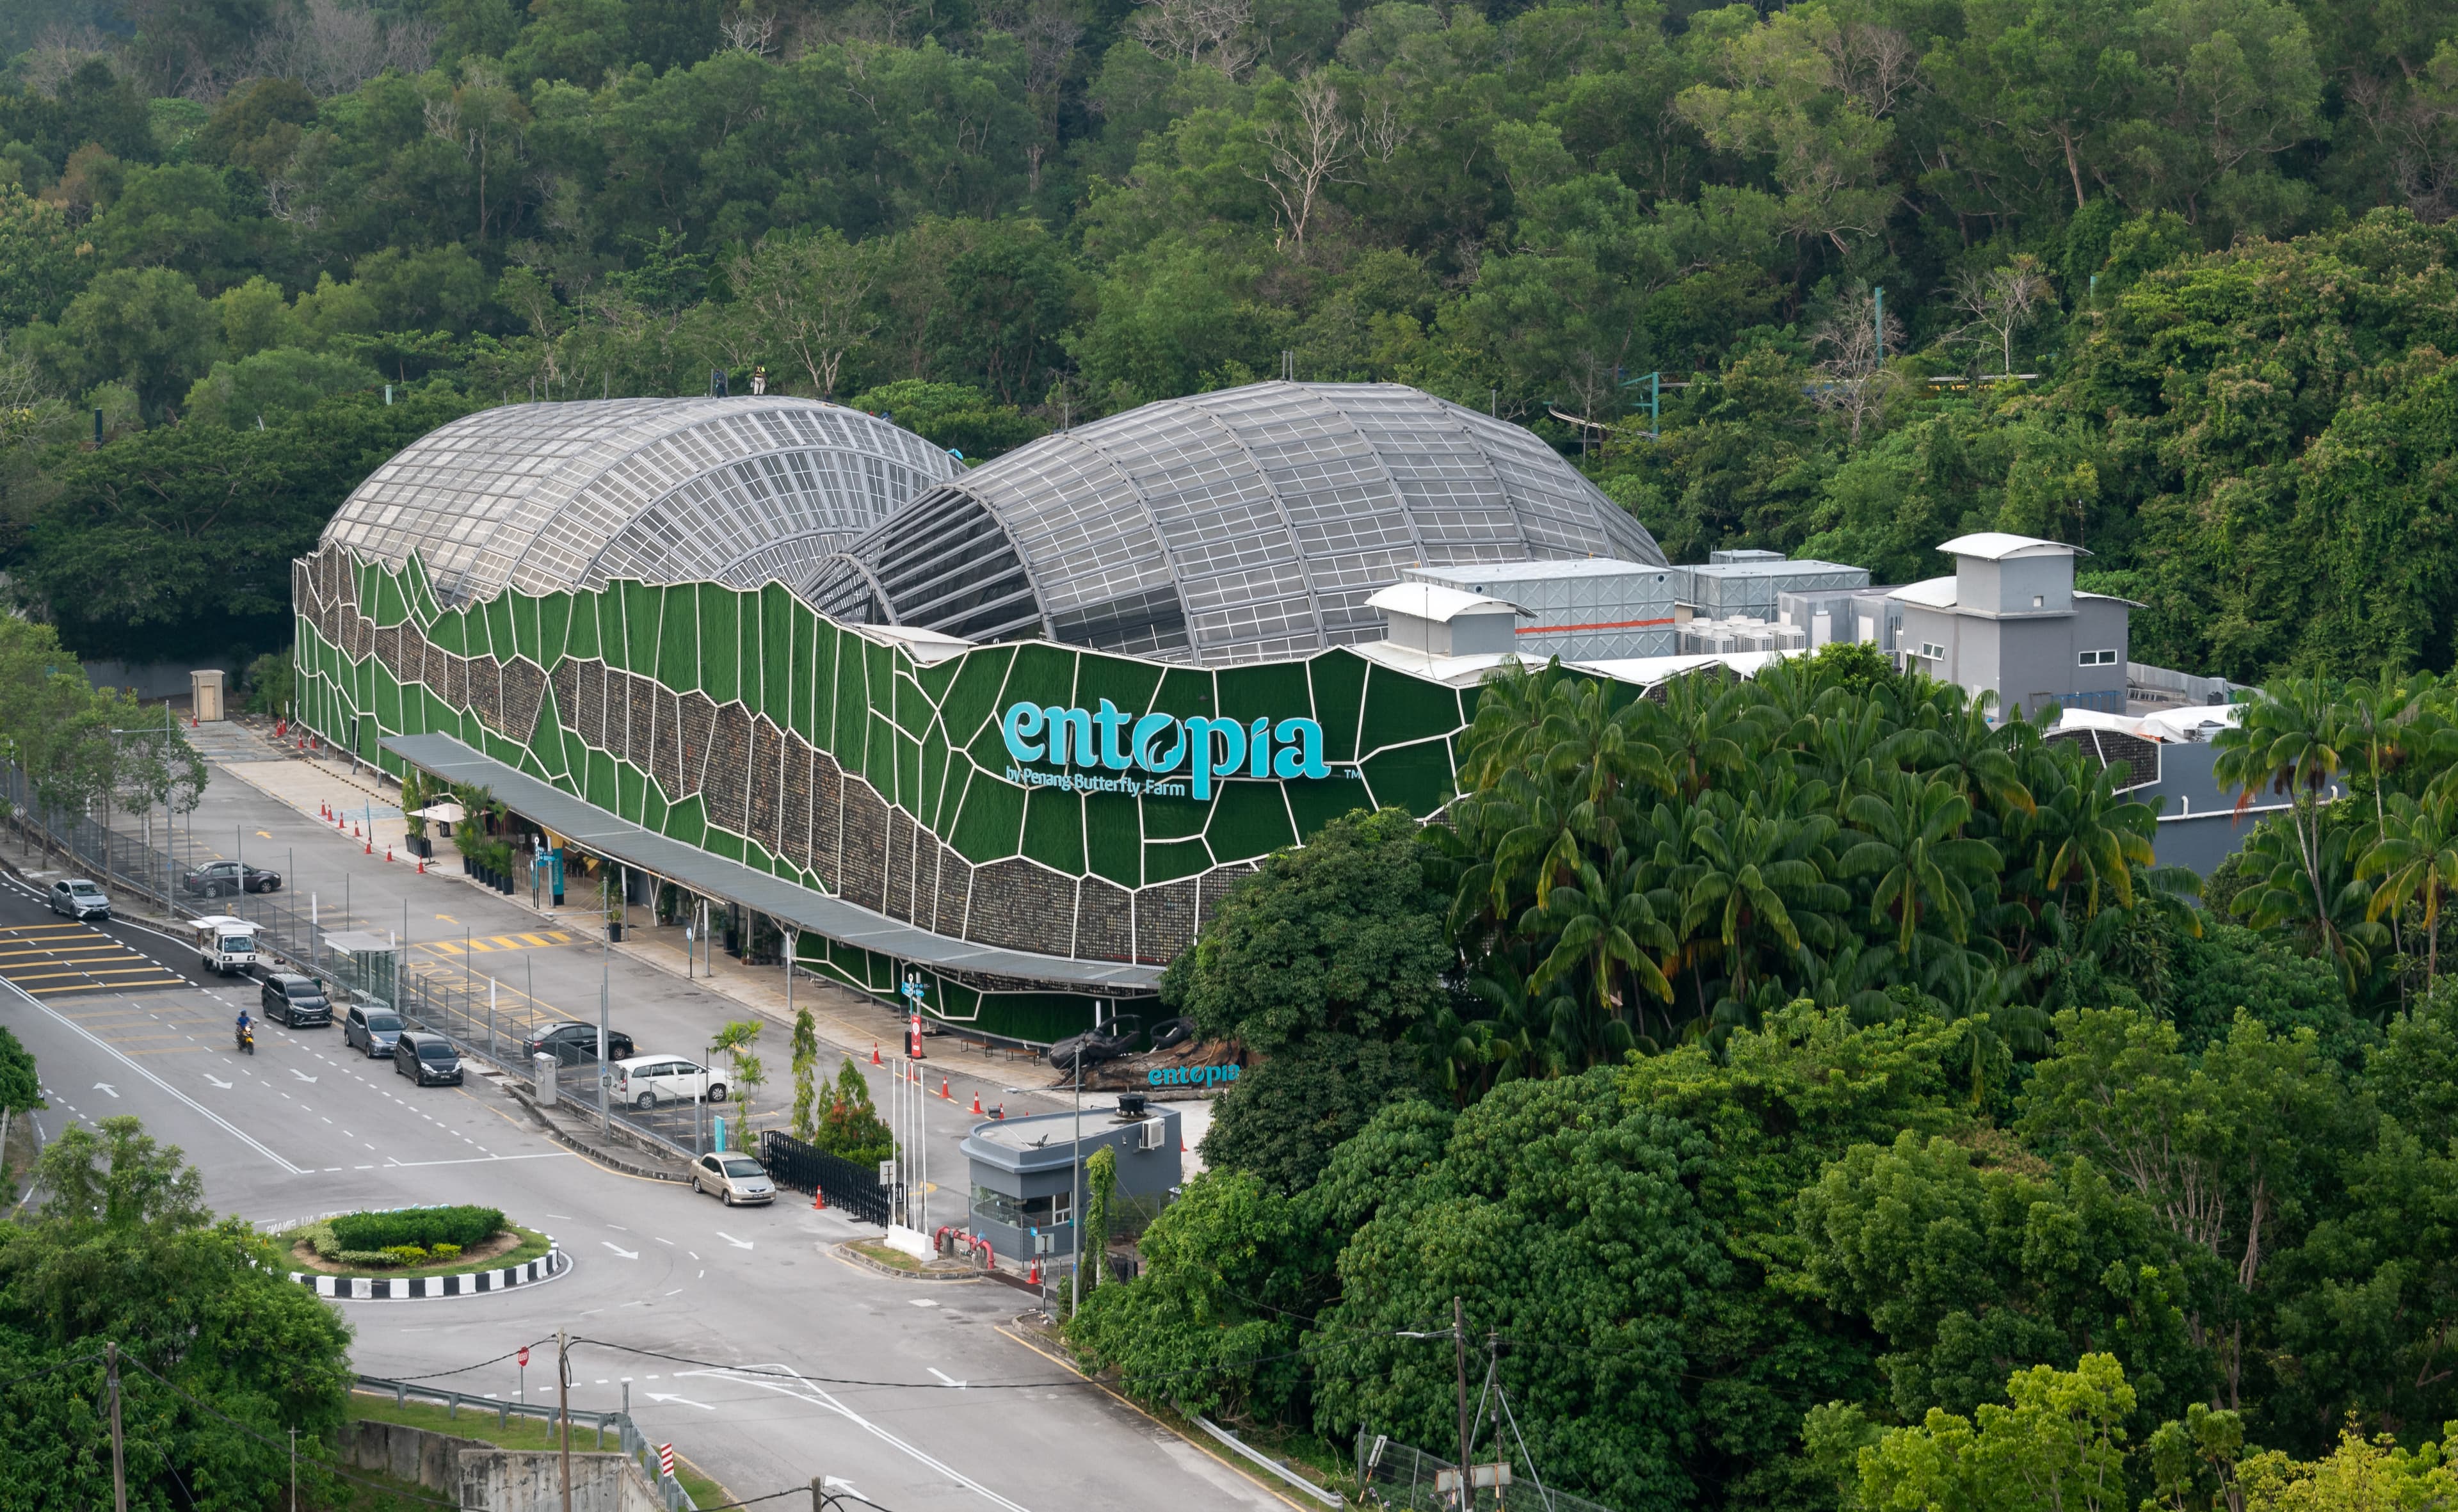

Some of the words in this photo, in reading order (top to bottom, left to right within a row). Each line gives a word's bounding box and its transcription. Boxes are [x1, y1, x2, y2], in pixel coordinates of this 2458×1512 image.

[1003, 698, 1331, 800] entopia
[1006, 766, 1021, 784] by
[1023, 768, 1071, 791] Penang
[1075, 773, 1140, 797] Butterfly
[1146, 779, 1185, 797] Farm
[1344, 769, 1361, 780] TM
[1148, 1064, 1241, 1088] entopia
